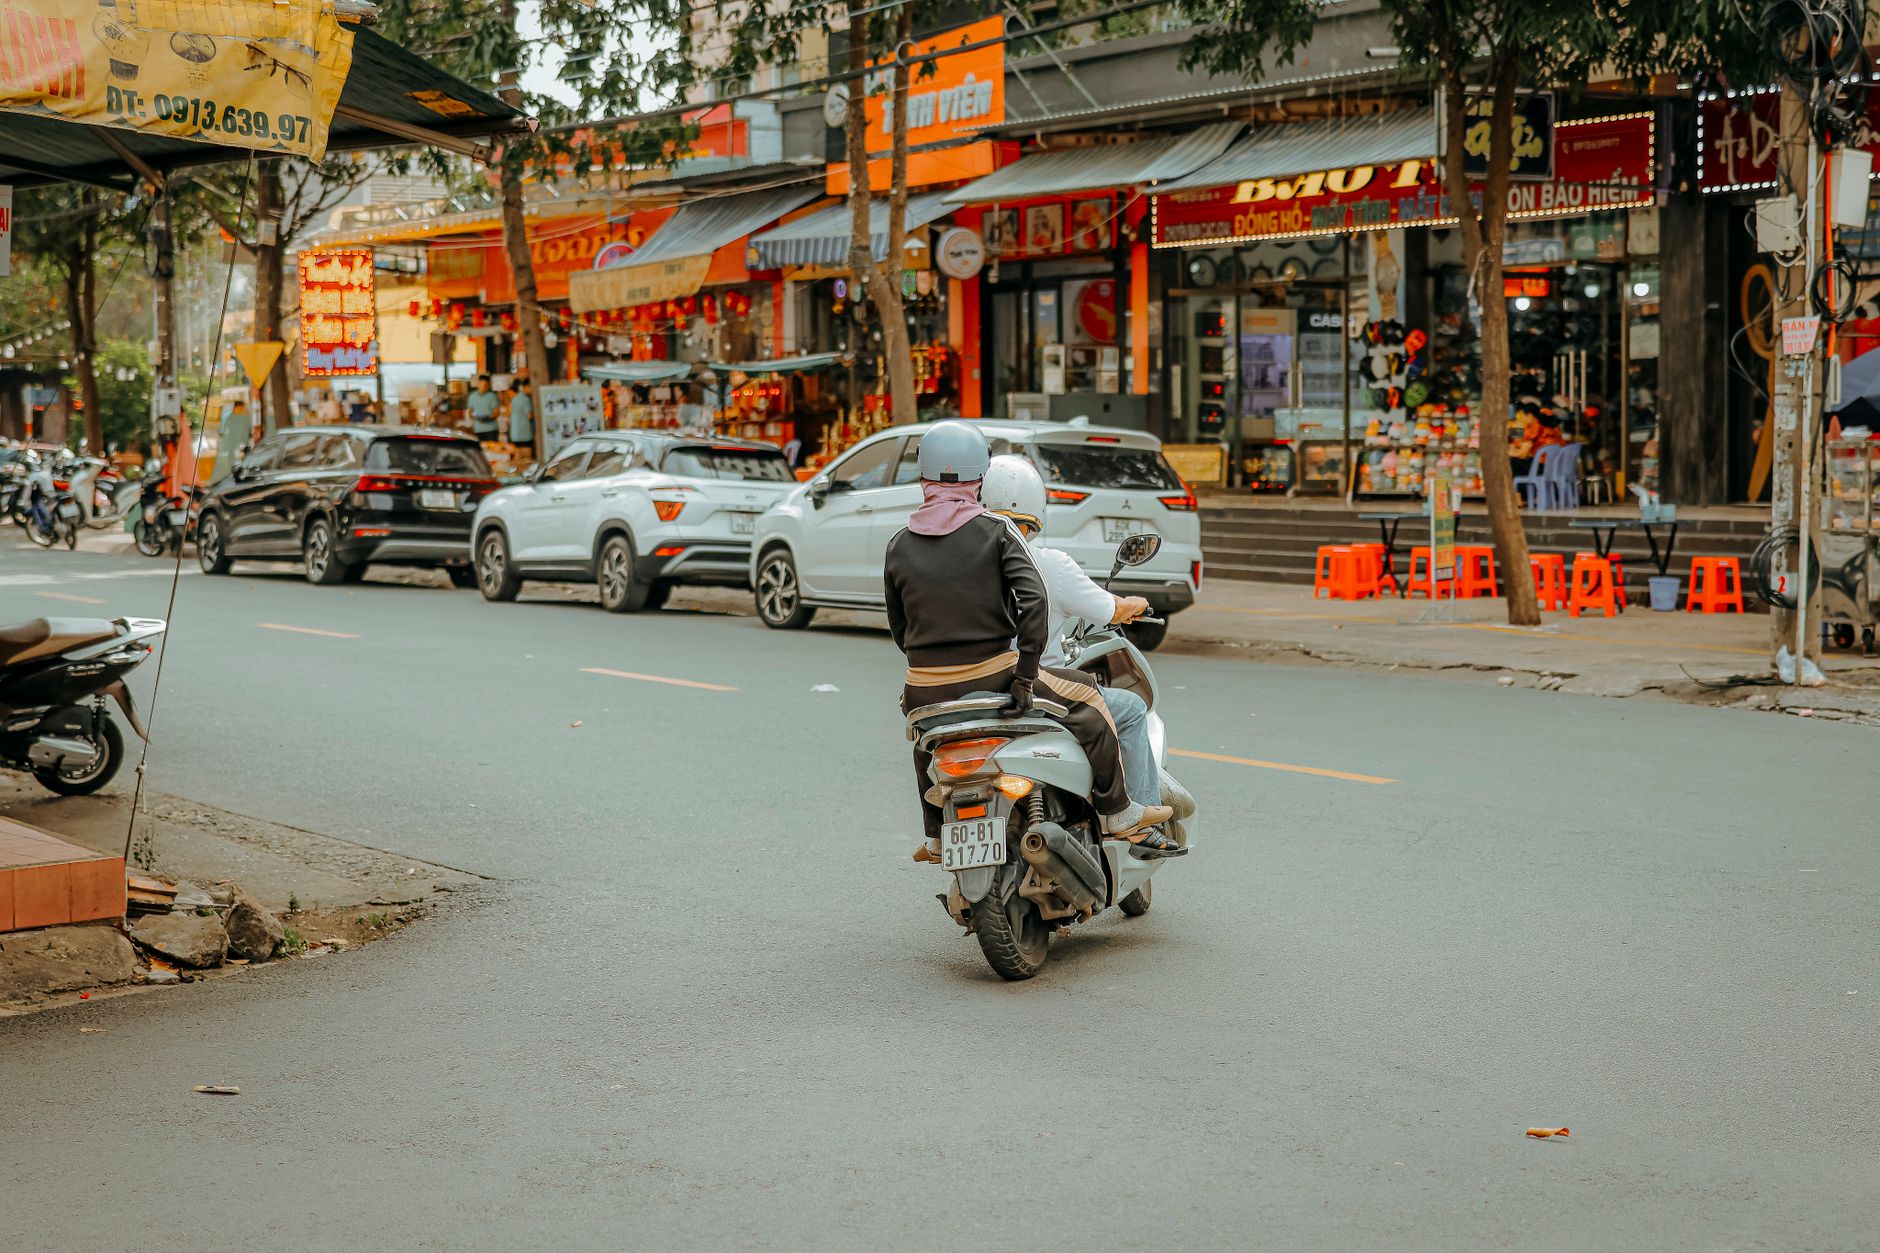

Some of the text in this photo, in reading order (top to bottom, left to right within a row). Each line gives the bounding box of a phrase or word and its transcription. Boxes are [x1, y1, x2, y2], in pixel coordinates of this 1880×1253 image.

[106, 84, 147, 118] ĐT:
[938, 72, 994, 123] VIÊN
[1777, 575, 1786, 593] 2
[950, 821, 994, 846] 60-B1
[945, 842, 1001, 868] 317.70
